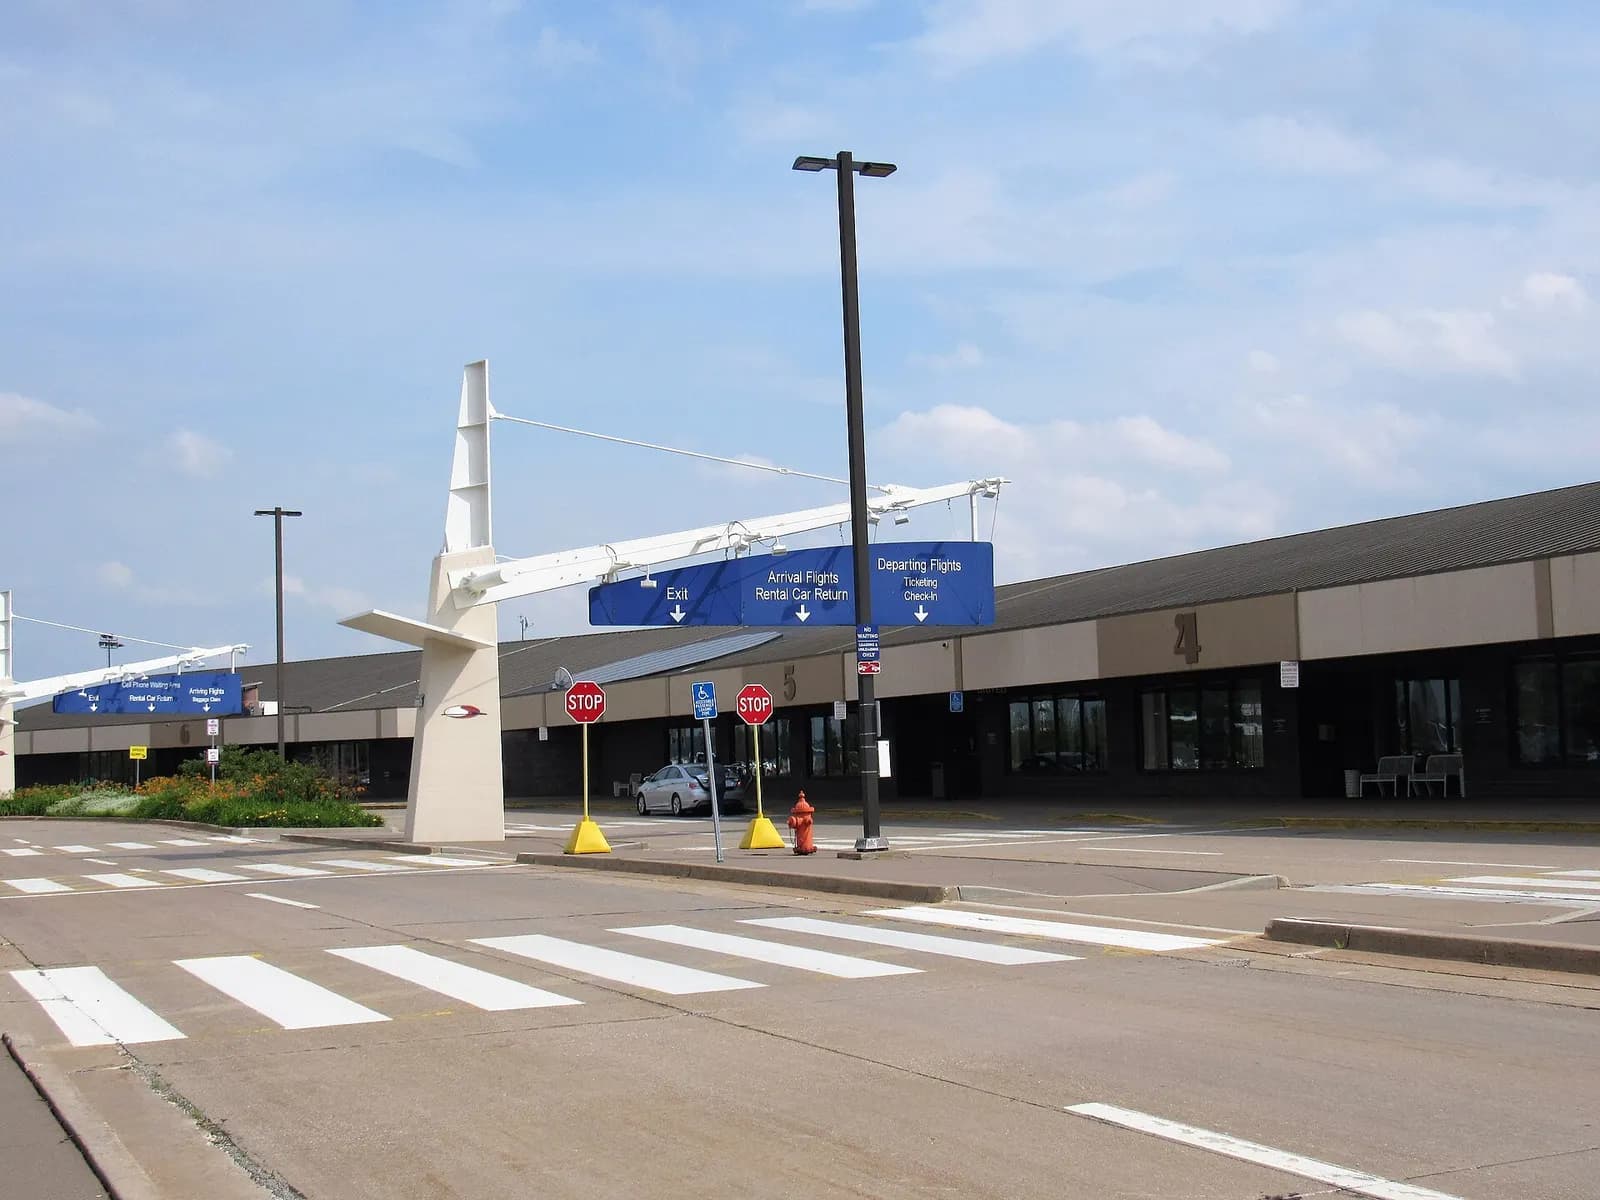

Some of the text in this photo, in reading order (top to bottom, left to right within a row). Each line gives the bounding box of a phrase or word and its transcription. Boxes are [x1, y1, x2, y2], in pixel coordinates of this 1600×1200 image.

[878, 558, 961, 573] Departing Flights
[768, 570, 839, 586] Arrival Flights
[903, 576, 938, 589] Ticketing
[667, 587, 688, 600] Exit
[755, 587, 848, 600] Rental Car Return
[904, 591, 938, 601] Check-In
[1174, 612, 1201, 664] 4
[150, 681, 168, 690] Waiting
[784, 664, 796, 702] 5
[129, 694, 145, 702] Rental
[157, 694, 173, 702] Return
[189, 687, 225, 696] Arriving Flights
[568, 694, 603, 710] STOP
[740, 697, 770, 713] STOP
